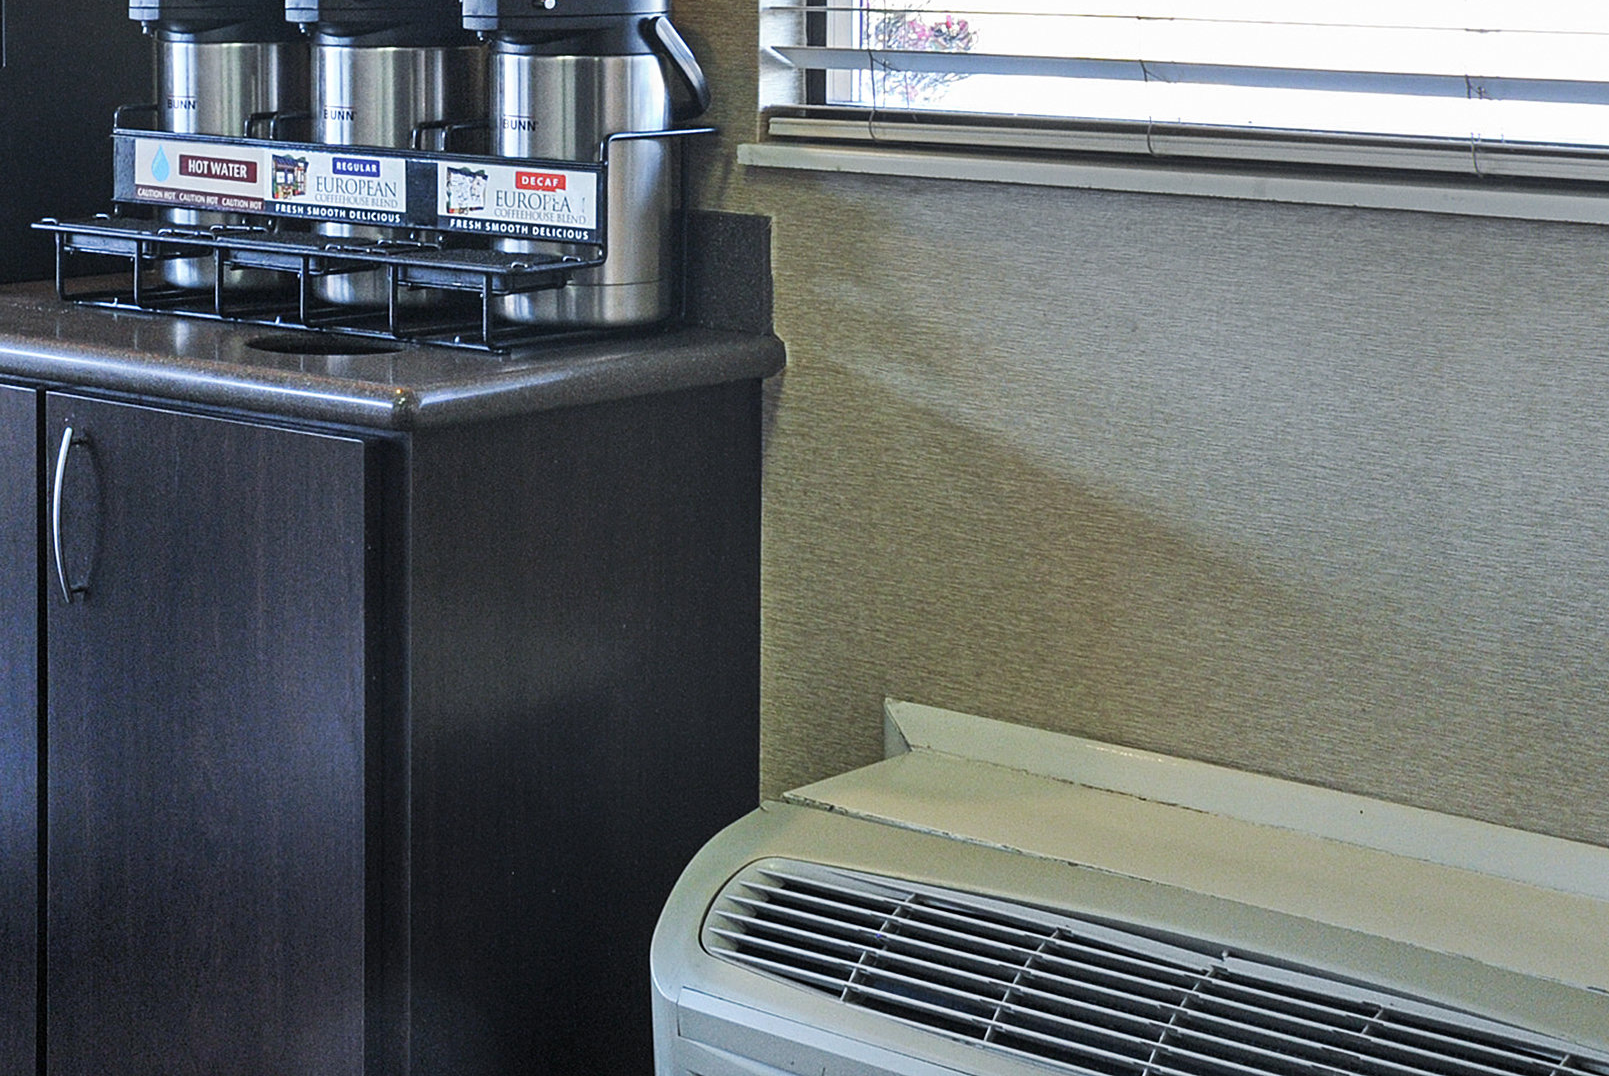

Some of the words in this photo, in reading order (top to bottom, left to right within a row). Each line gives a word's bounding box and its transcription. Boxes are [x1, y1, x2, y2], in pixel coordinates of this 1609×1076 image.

[167, 99, 196, 110] BUNN
[323, 108, 354, 121] BUNN
[503, 118, 536, 132] BUNN
[188, 158, 209, 174] HOT
[210, 162, 247, 179] WATER
[336, 161, 377, 173] REGULAR
[316, 176, 398, 198] EUROPEAN
[521, 175, 560, 188] DECAF
[137, 187, 163, 199] CAUTION
[163, 190, 176, 201] HOT
[179, 191, 205, 204] CAUTION
[206, 195, 218, 205] HOT
[314, 192, 371, 206] COFFEEHOUSE
[371, 197, 399, 209] BLEND
[221, 197, 248, 208] CAUTION
[249, 200, 262, 210] HOT
[275, 203, 304, 215] FRESH
[306, 206, 346, 219] SMOOTH
[349, 210, 401, 224] DELICIOUS
[493, 208, 555, 223] COFFEEHOUSE
[556, 213, 587, 225] BLEND
[450, 218, 482, 231] FRESH
[485, 221, 529, 235] SMOOTH
[532, 226, 589, 241] DELICIOUS
